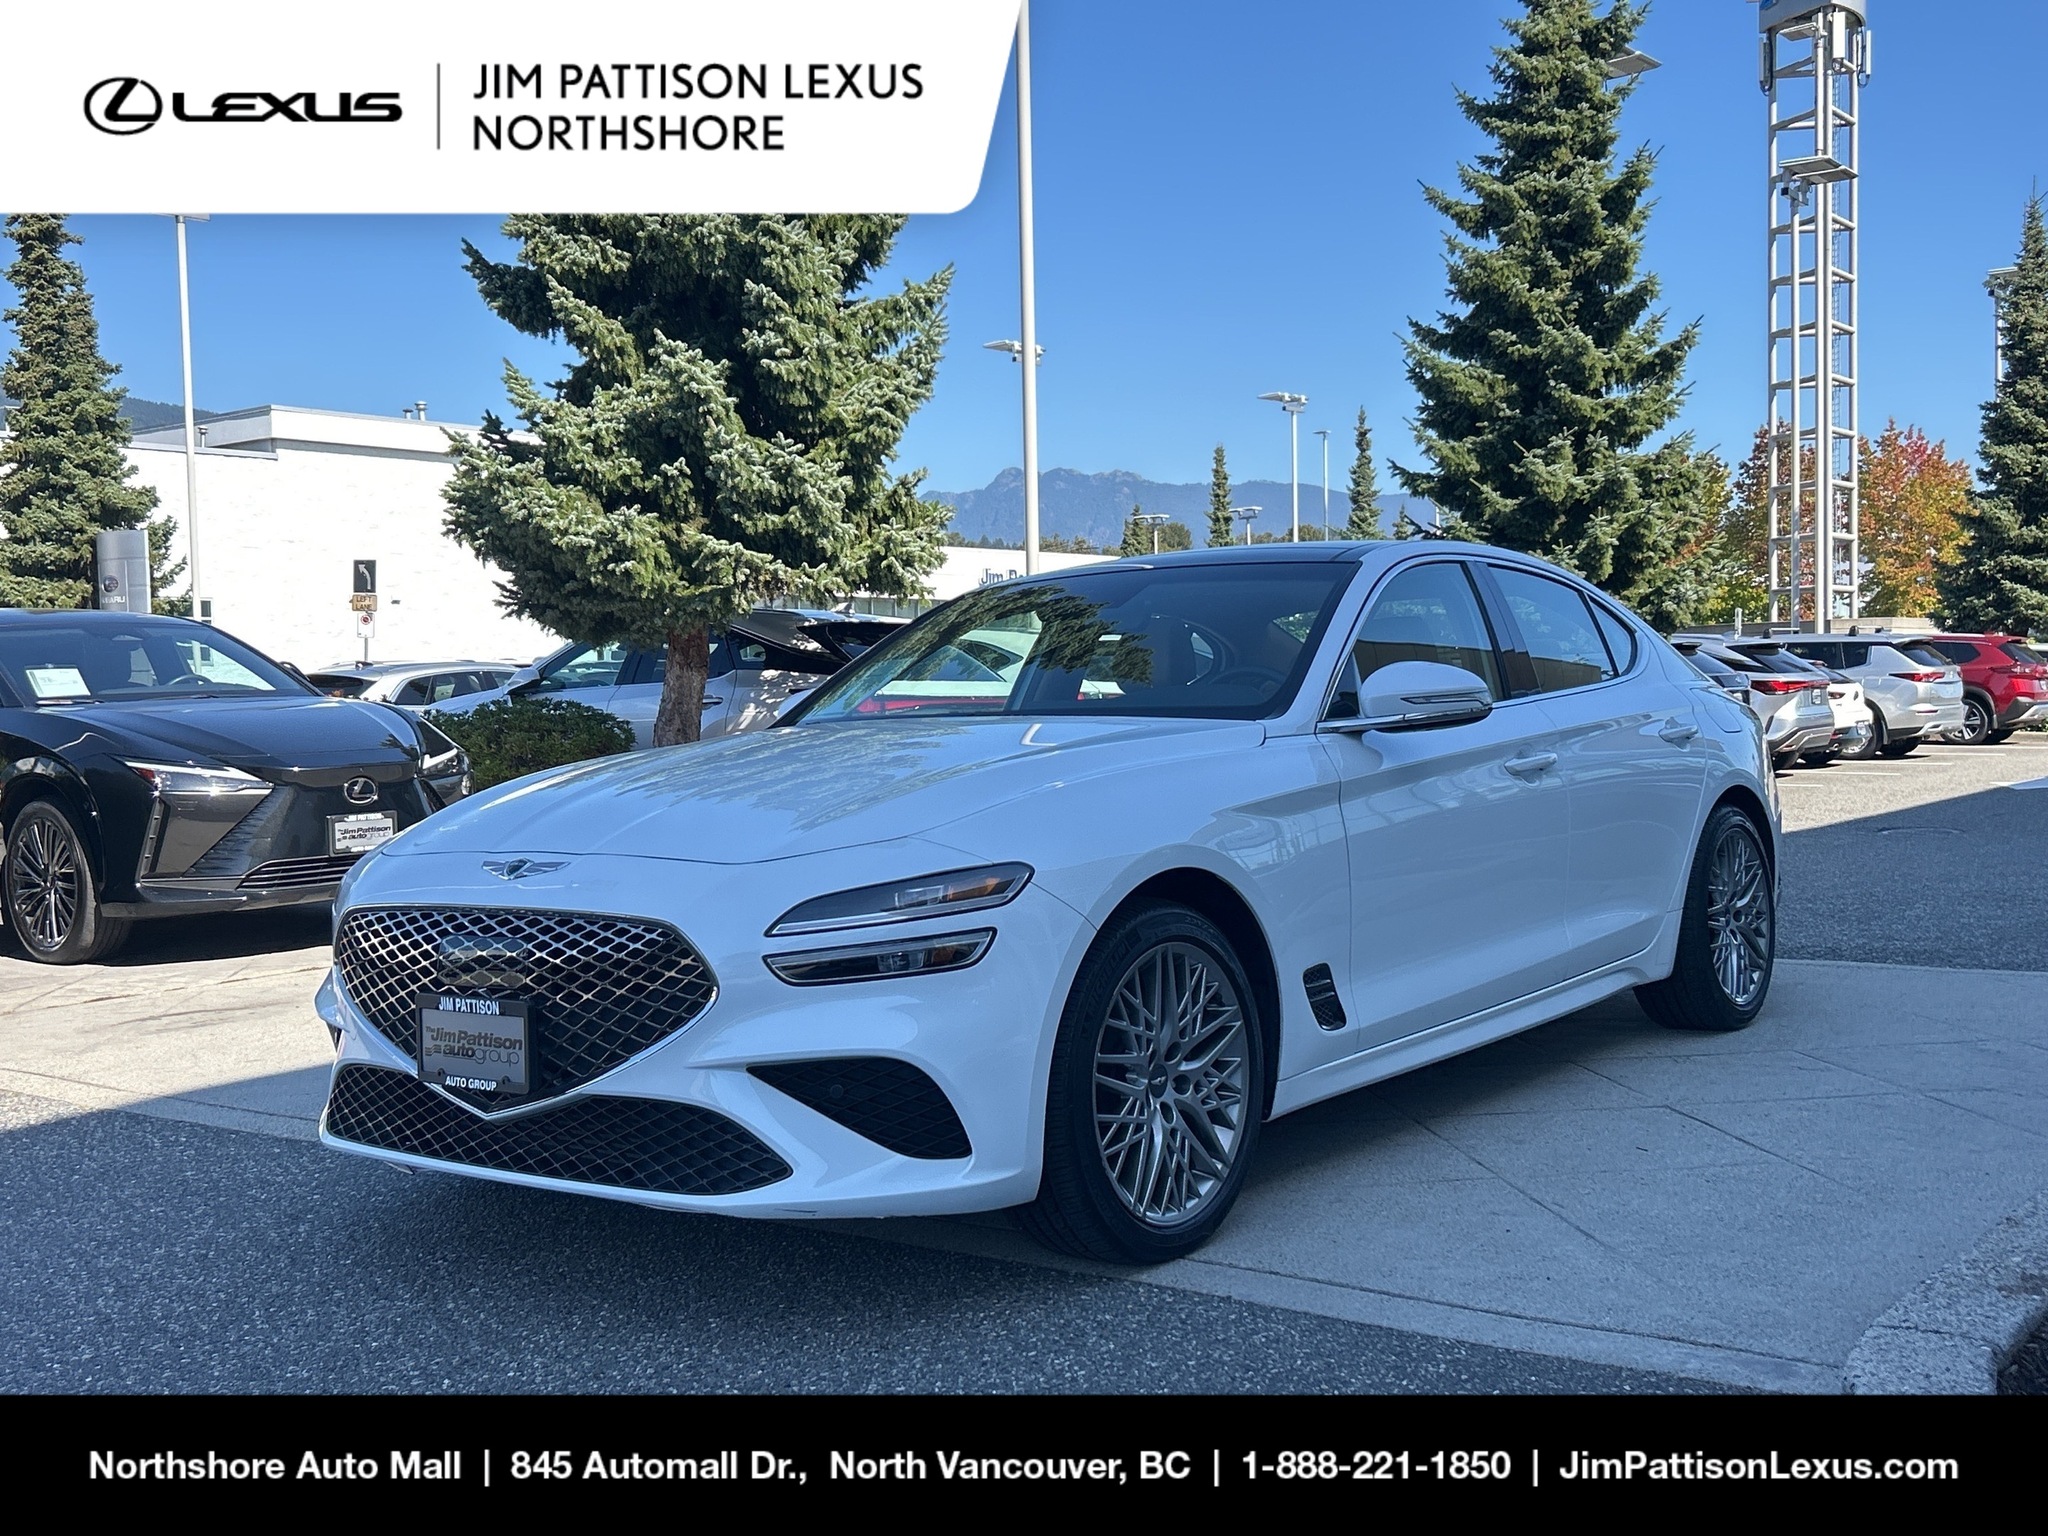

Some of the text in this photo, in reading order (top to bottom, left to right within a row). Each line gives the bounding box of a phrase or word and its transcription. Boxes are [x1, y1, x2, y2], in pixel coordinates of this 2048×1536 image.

[356, 595, 372, 603] LEFT
[356, 825, 391, 833] Pattison
[438, 996, 500, 1016] JIM PATTISON
[430, 1027, 456, 1043] Jim
[457, 1029, 523, 1051] Pattison
[444, 1075, 497, 1091] AUTO GROUP
